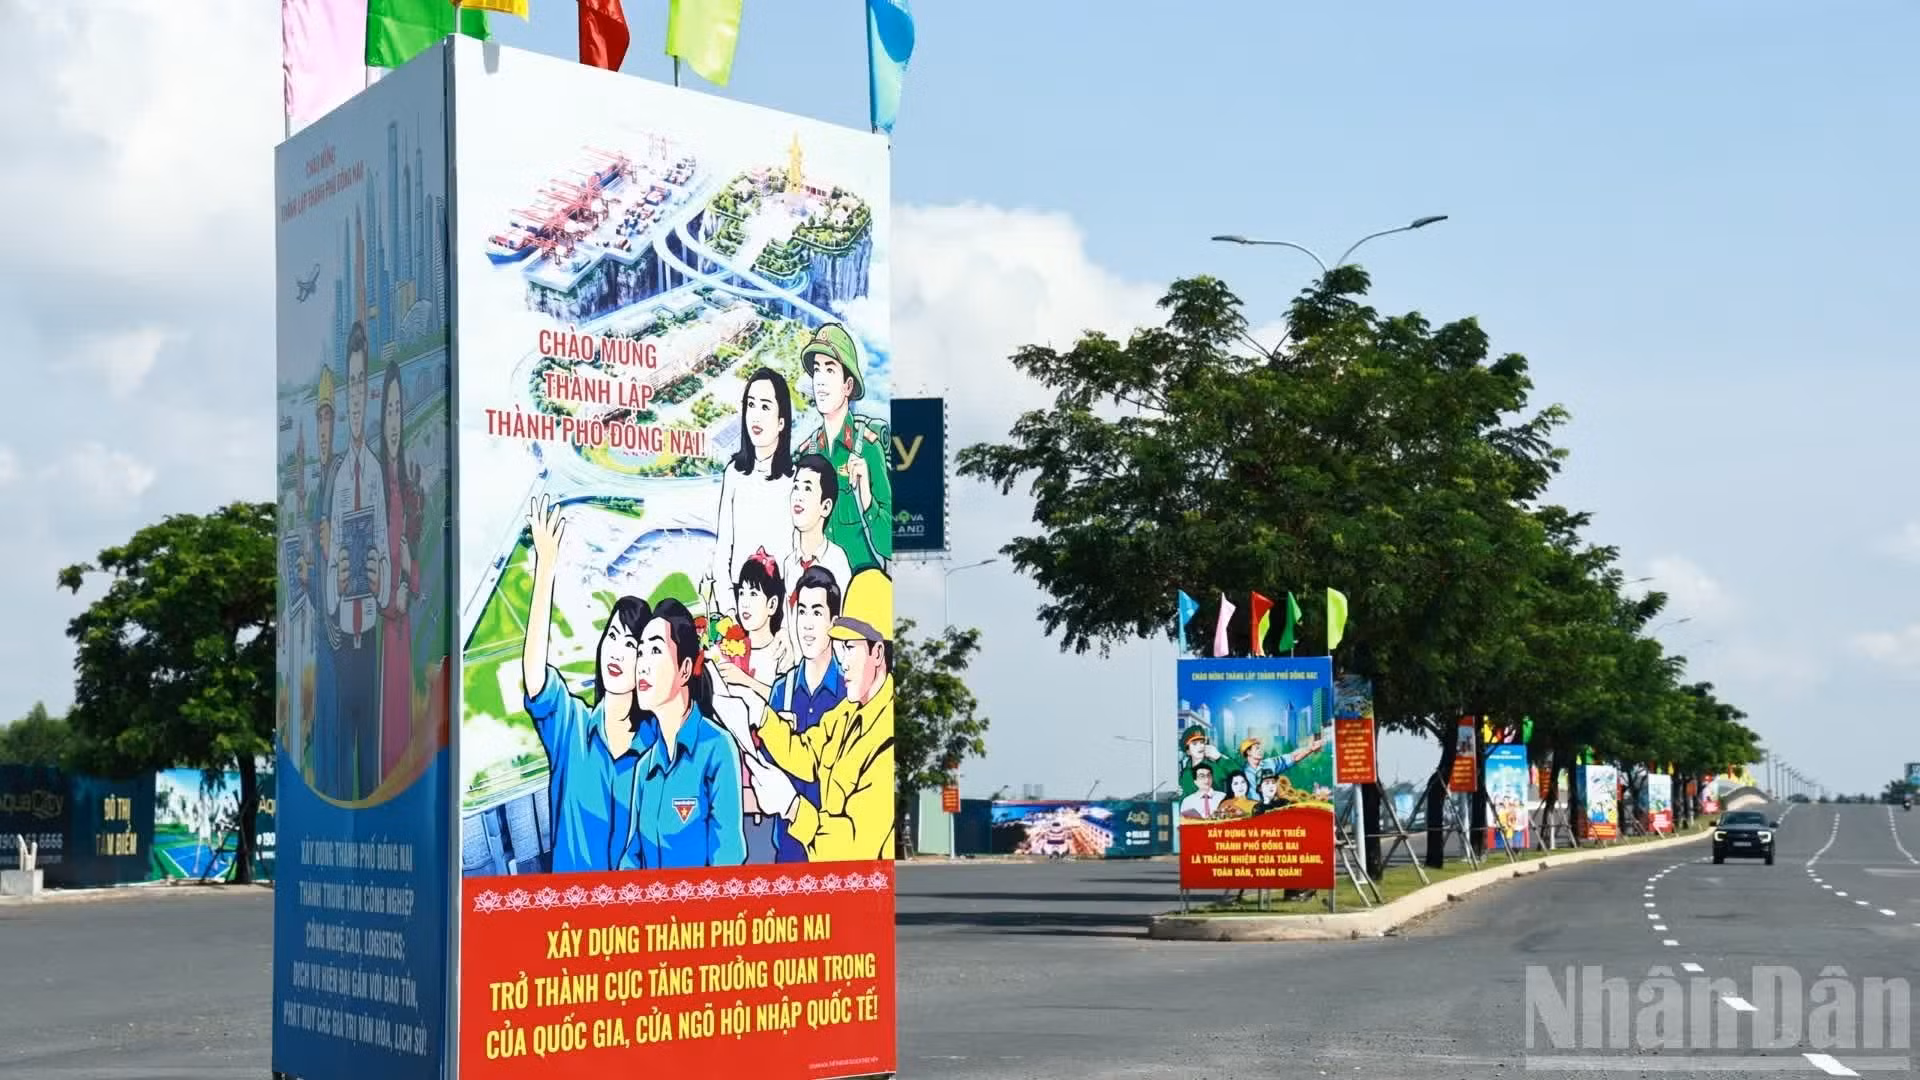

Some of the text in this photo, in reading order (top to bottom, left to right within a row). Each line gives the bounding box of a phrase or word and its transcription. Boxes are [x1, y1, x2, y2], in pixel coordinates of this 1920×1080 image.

[539, 326, 657, 369] CHÀO MỪNG
[545, 369, 653, 413] THÀNH LẬP
[485, 404, 706, 457] THÀNH PHỐ ĐỒNG NAI!
[891, 525, 925, 534] AND
[546, 906, 831, 962] XÂY DỰNG THÀNH PHỐ ĐỒNG NAI
[490, 952, 876, 1012] TRỞ THÀNH CỰC TĂNG TRƯỞNG QUAN TRỌNG
[486, 986, 878, 1060] CỦA QUỐC GIA, CỬA NGÕ HỘI NHẬP QUỐC TẾ!
